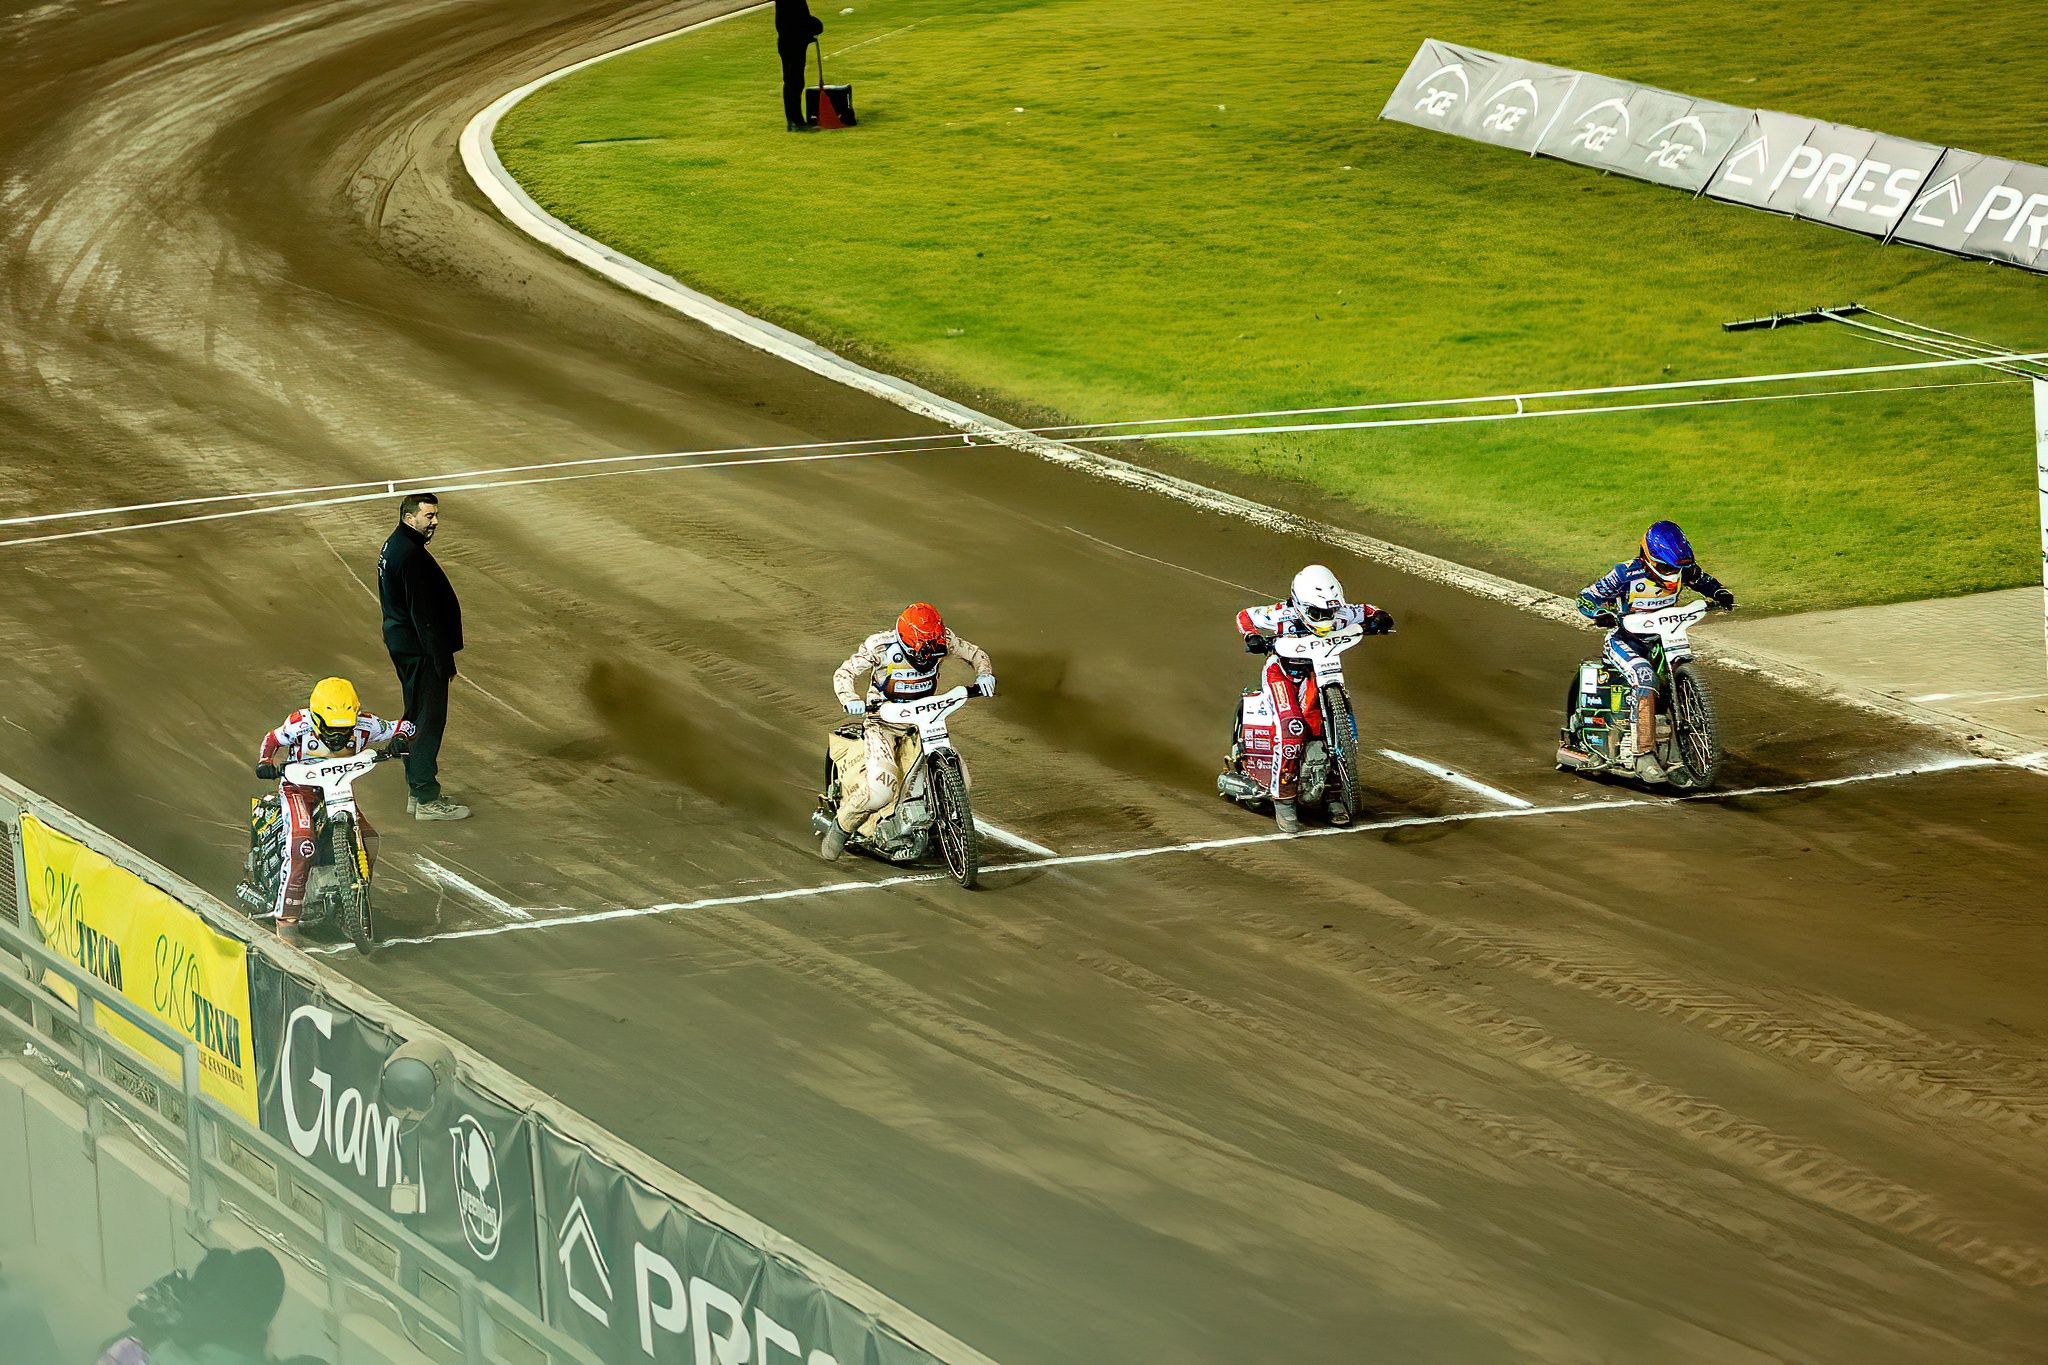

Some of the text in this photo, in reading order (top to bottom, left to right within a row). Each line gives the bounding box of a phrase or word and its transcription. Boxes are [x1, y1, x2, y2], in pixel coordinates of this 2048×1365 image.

[1768, 145, 1922, 218] PRES
[1963, 184, 2048, 250] PR
[1658, 613, 1698, 626] PRES
[1309, 635, 1351, 650] PRES
[915, 697, 955, 715] PRES
[320, 761, 366, 777] PRES
[633, 1241, 842, 1365] PR
